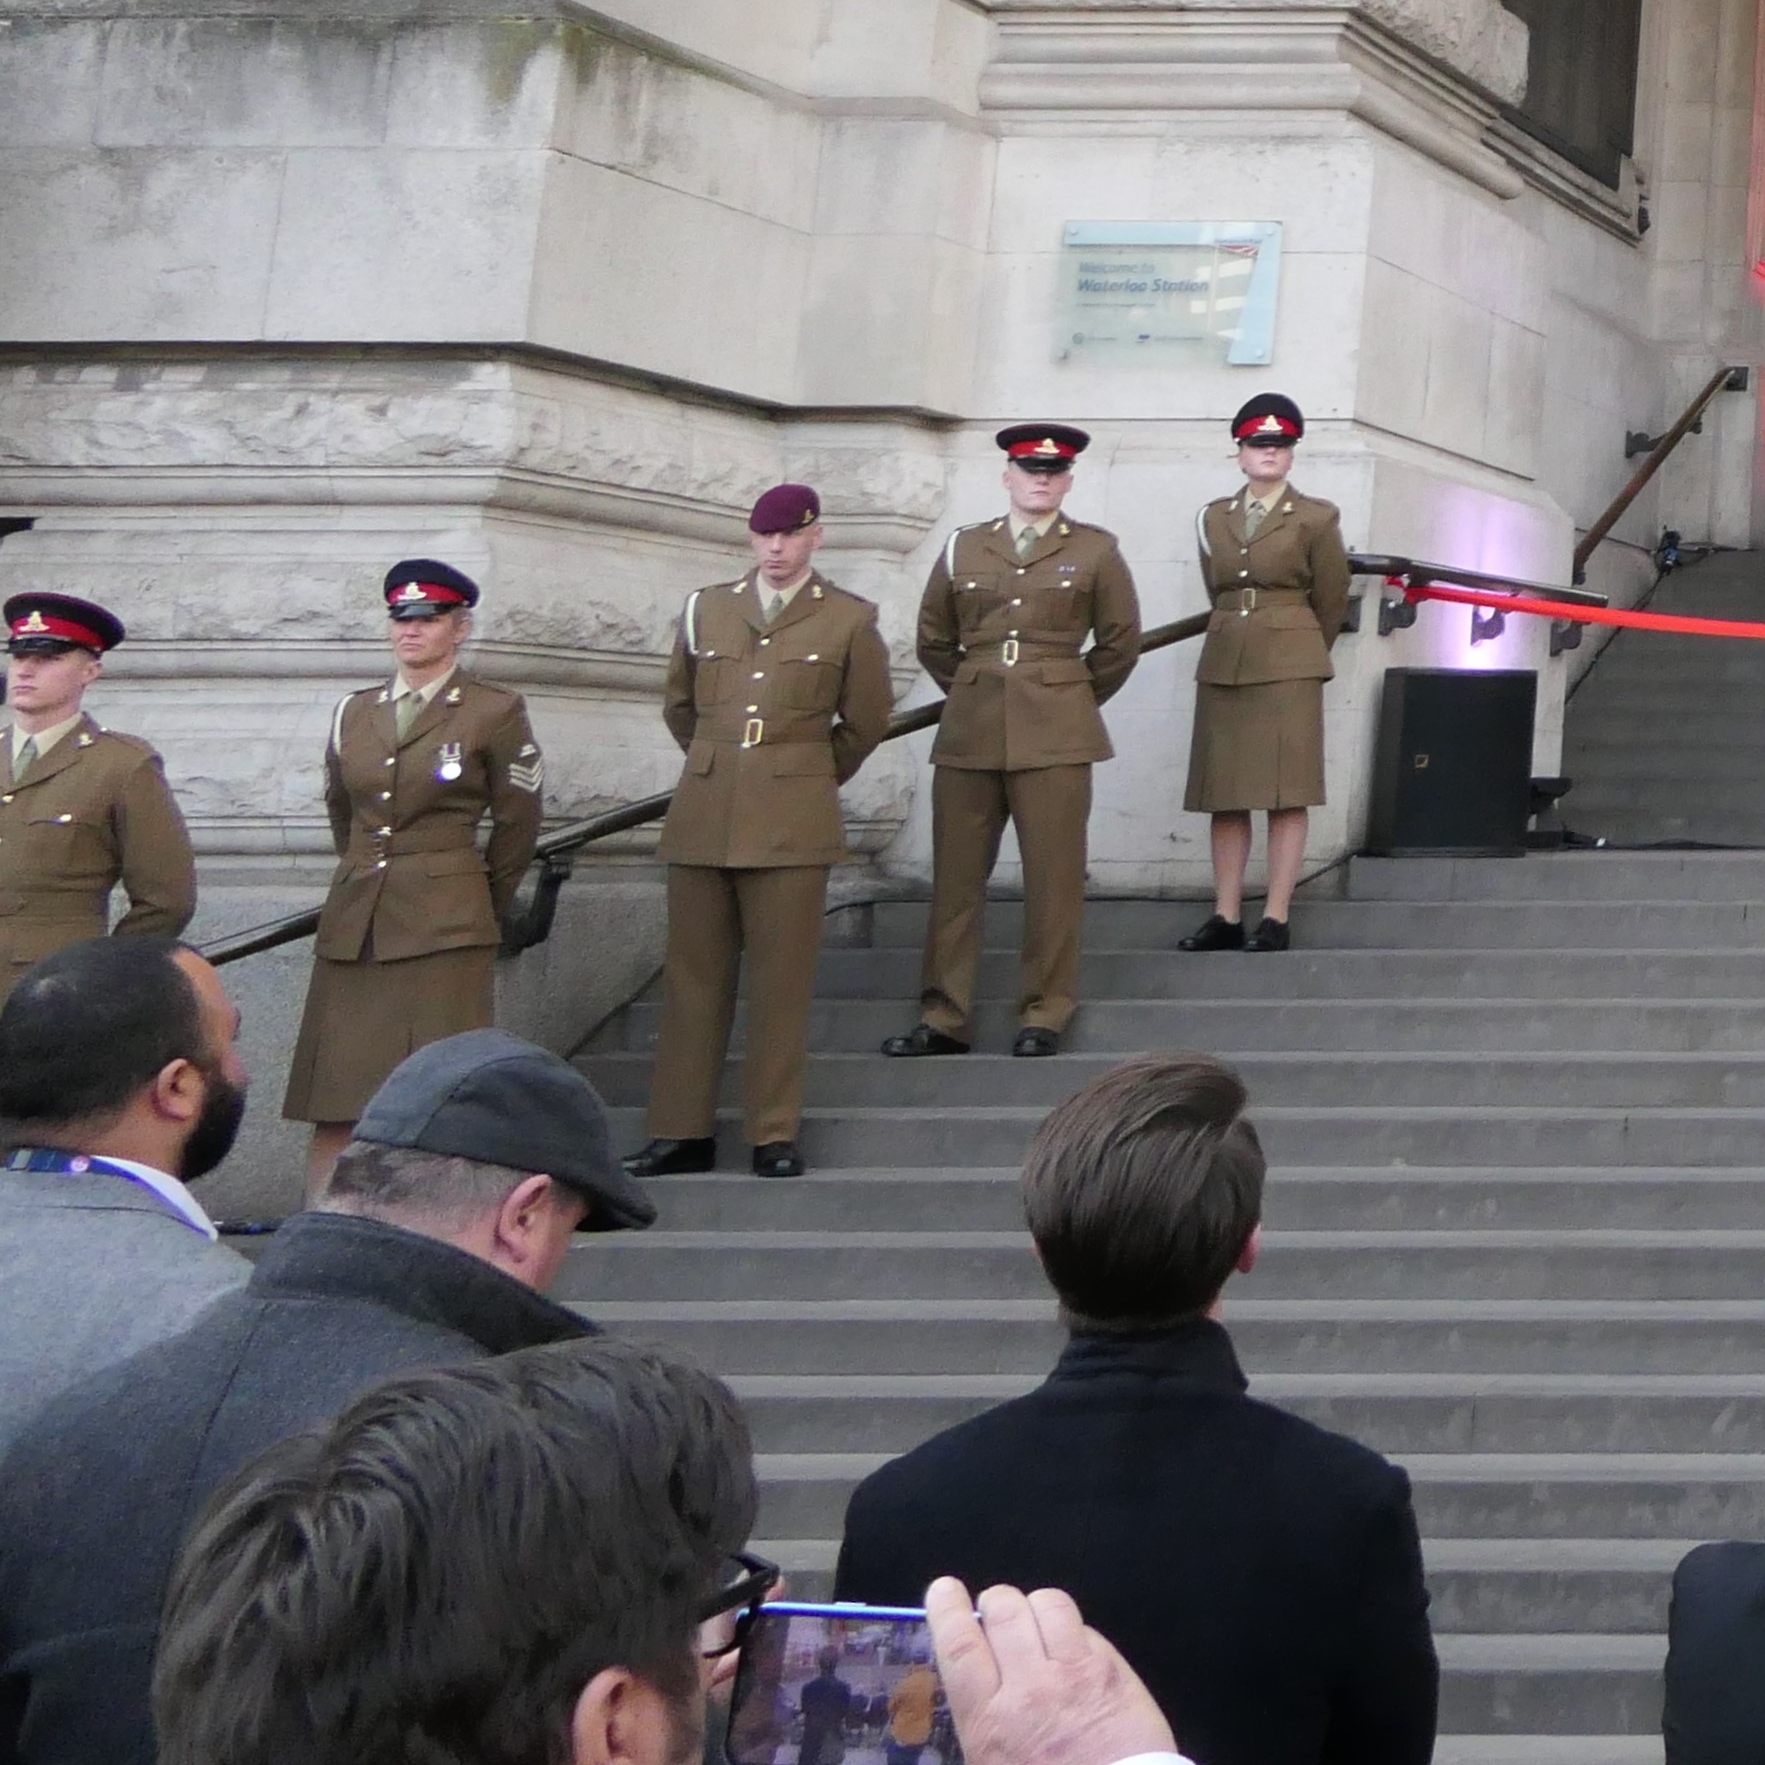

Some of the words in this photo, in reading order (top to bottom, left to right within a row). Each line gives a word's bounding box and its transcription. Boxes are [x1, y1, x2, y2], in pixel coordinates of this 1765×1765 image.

[1079, 261, 1138, 274] Welcome
[1077, 278, 1149, 293] Waterloo
[1151, 277, 1209, 293] Station
